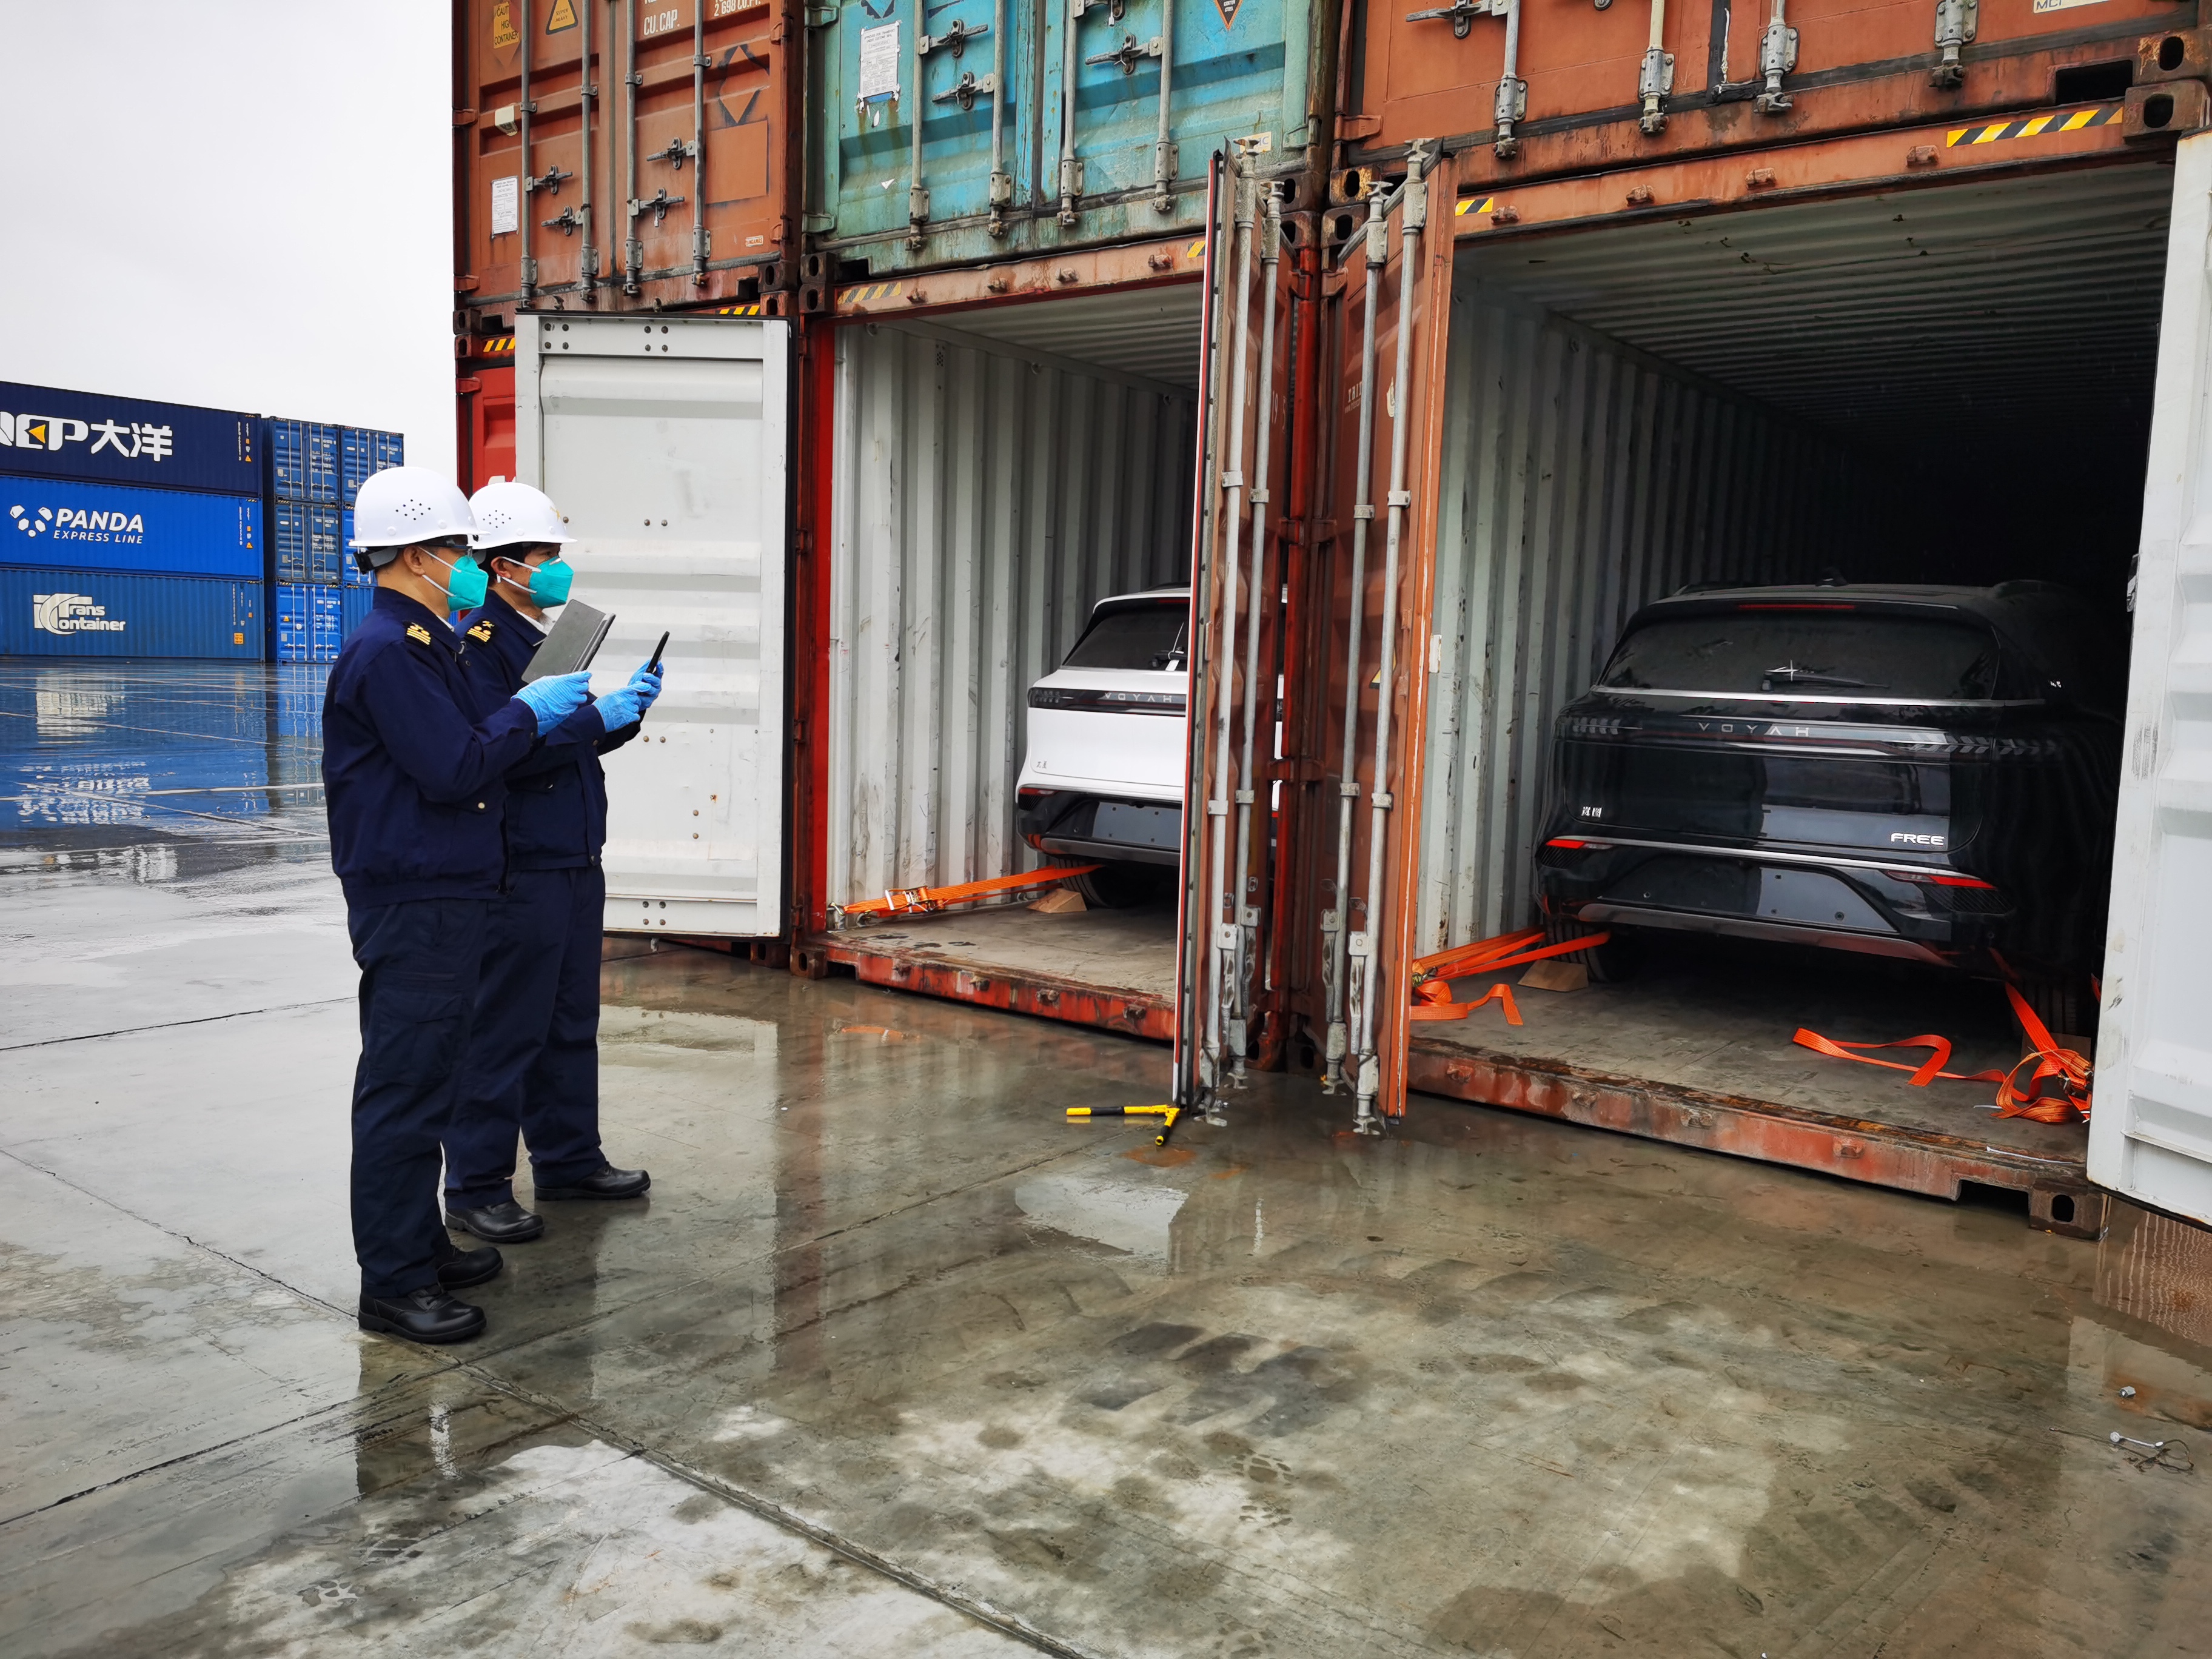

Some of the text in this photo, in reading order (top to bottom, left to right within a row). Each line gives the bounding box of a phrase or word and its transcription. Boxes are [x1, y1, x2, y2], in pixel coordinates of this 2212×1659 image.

[497, 5, 509, 17] CAUT
[90, 419, 173, 462] 大洋
[55, 508, 144, 533] PANDA
[53, 530, 143, 544] EXPRESS LINE
[58, 596, 106, 618] Trans
[1104, 692, 1172, 703] VOYAH
[1698, 722, 1809, 737] VOYAH
[1891, 833, 1945, 846] FREE
